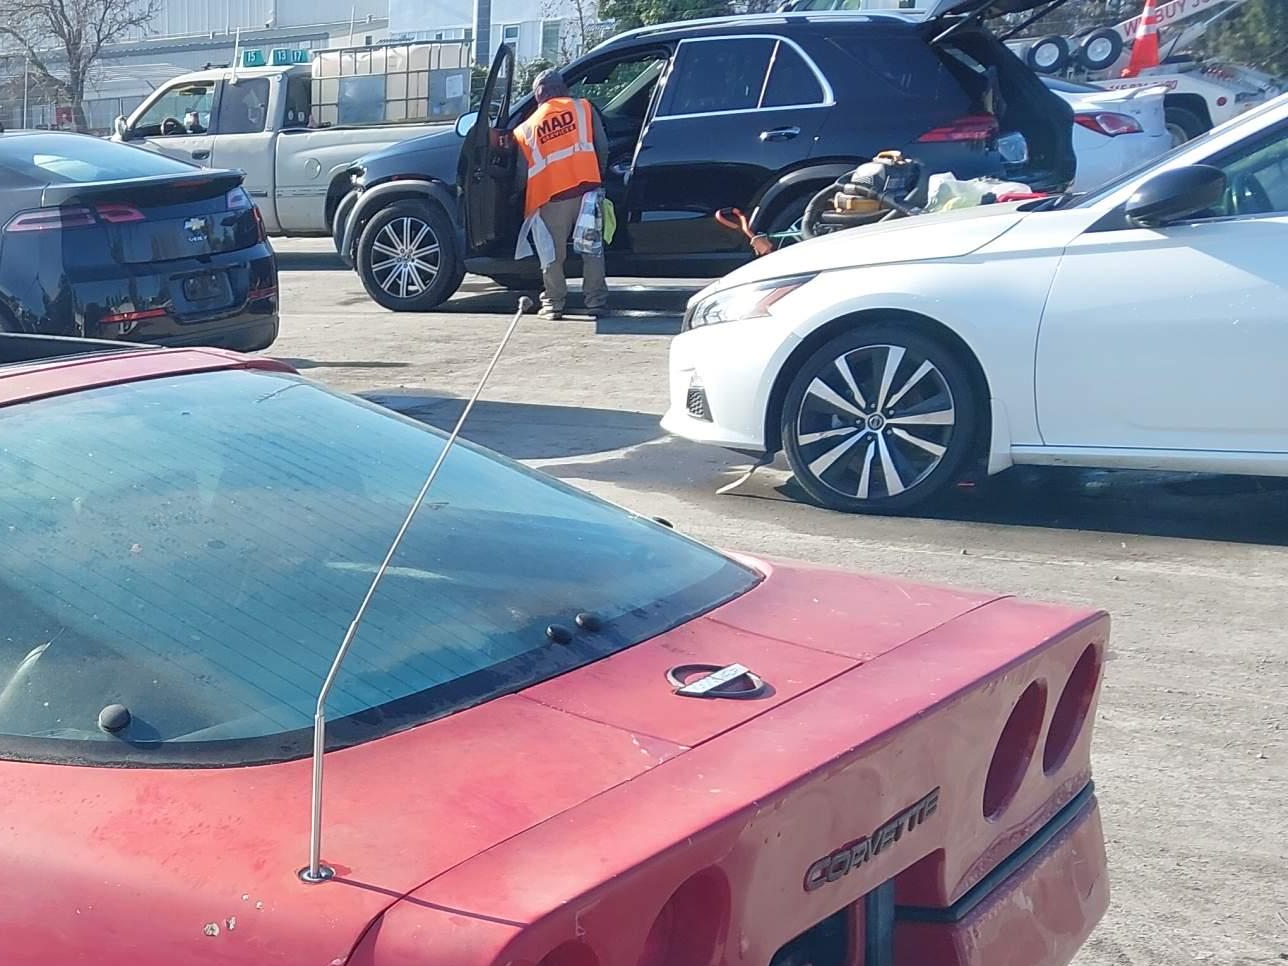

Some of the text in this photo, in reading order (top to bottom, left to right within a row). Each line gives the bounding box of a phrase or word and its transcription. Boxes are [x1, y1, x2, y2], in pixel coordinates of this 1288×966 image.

[1124, 17, 1141, 37] W
[247, 51, 257, 62] 15
[277, 50, 288, 61] 13
[294, 50, 303, 61] 17
[537, 111, 574, 138] MAD
[803, 786, 941, 892] CORVETTE
